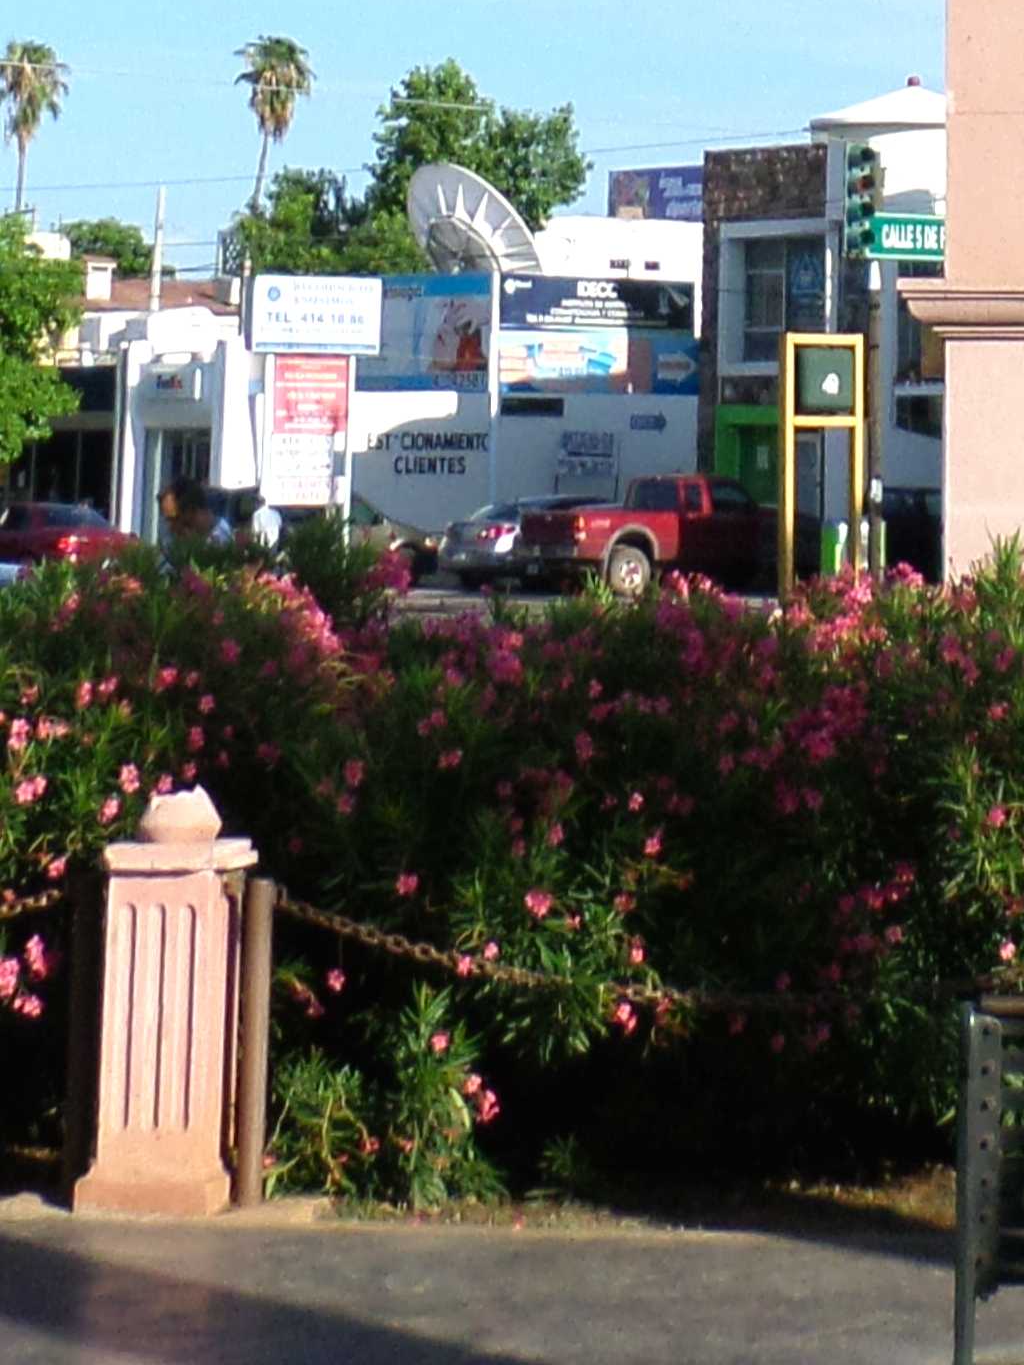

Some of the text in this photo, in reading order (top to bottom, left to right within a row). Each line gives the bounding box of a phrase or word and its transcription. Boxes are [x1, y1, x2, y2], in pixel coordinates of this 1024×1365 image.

[882, 224, 914, 249] CALLE
[915, 224, 922, 249] 5
[924, 225, 938, 249] DE
[367, 432, 488, 451] ESTCIONAMIENTO
[394, 456, 466, 475] CLIENTES
